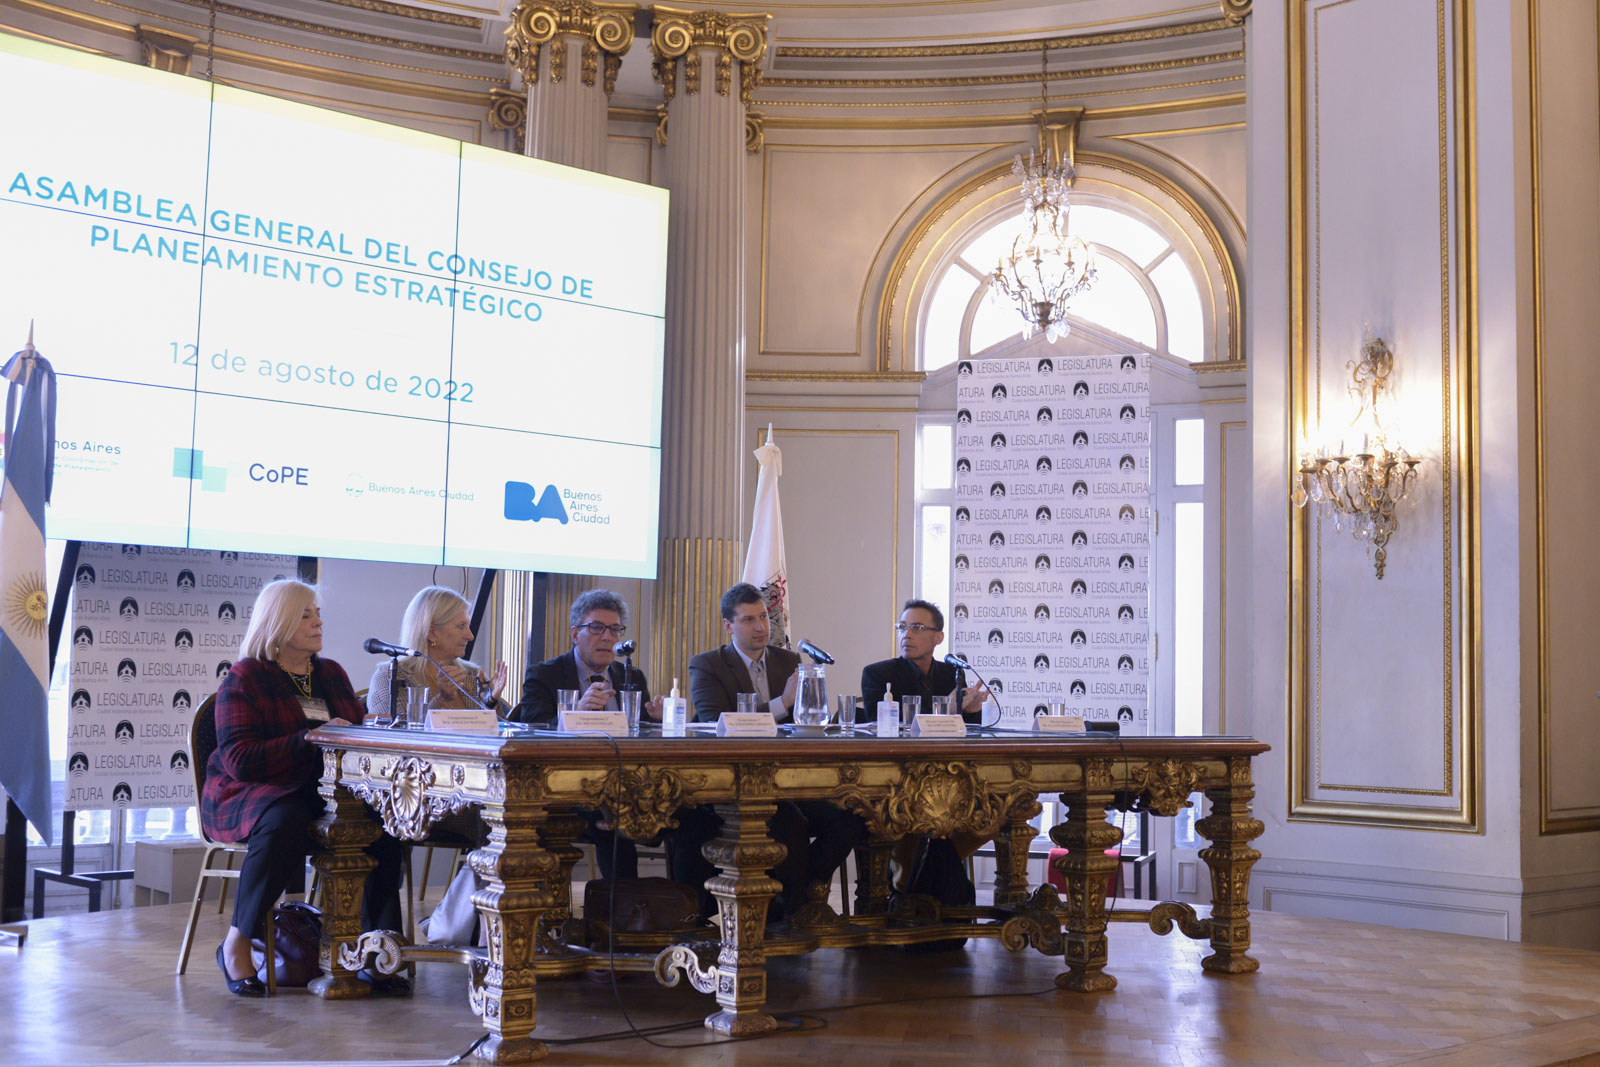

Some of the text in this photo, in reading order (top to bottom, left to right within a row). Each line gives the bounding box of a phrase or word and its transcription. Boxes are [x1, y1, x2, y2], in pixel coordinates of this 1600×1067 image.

[9, 172, 594, 298] ASAMBLEA GENERAL DEL CONSEJO DE
[90, 225, 543, 322] PLANEAMIENTO ESTRATÉGICO
[977, 361, 1030, 373] LEGISLATURA
[1058, 358, 1112, 370] LEGISLATURA
[169, 341, 474, 403] 12 de agosto de 2022
[1012, 385, 1065, 396] LEGISLATURA
[1094, 382, 1149, 394] LEGISLATURA
[976, 410, 1030, 422] LEGISLATURA
[1057, 408, 1112, 420] LEGISLATURA
[1011, 434, 1065, 446] LEGISLATURA
[1093, 432, 1148, 444] LEGISLATURA
[82, 441, 121, 455] Aires
[976, 460, 1029, 471] LEGISLATURA
[1057, 458, 1111, 469] LEGISLATURA
[249, 463, 308, 486] CoPE
[369, 483, 474, 501] Buenos Aires Ciudad
[1010, 484, 1064, 495] LEGISLATURA
[1093, 482, 1148, 494] LEGISLATURA
[564, 489, 602, 502] Buenos
[570, 501, 598, 512] Aires
[573, 512, 610, 525] Ciudad
[975, 509, 1028, 520] LEGISLATURA
[1056, 508, 1111, 519] LEGISLATURA
[1010, 534, 1064, 544] LEGISLATURA
[1092, 533, 1147, 544] LEGISLATURA
[974, 557, 1027, 568] LEGISLATURA
[1056, 557, 1110, 567] LEGISLATURA
[102, 569, 168, 584] LEGISLATURA
[201, 574, 262, 587] LEGISLATURA
[1009, 582, 1063, 593] LEGISLATURA
[1092, 582, 1147, 593] LEGISLATURA
[144, 602, 209, 616] LEGISLATURA
[973, 607, 1027, 618] LEGISLATURA
[1055, 607, 1110, 618] LEGISLATURA
[99, 631, 166, 644] LEGISLATURA
[199, 633, 244, 647] LEGISLAT
[1008, 632, 1063, 643] LEGISLATURA
[1092, 633, 1147, 644] LEGISLATURA
[973, 657, 1026, 667] LEGISLATURA
[1055, 657, 1109, 668] LEGISLATURA
[143, 663, 207, 676] LEGISLATURA
[1008, 681, 1062, 692] LEGISLATURA
[1091, 682, 1146, 694] LEGISLATURA
[97, 692, 164, 706] LEGISLATURA
[140, 724, 187, 737] LEGISLAT
[95, 755, 161, 768] LEGISLATURA
